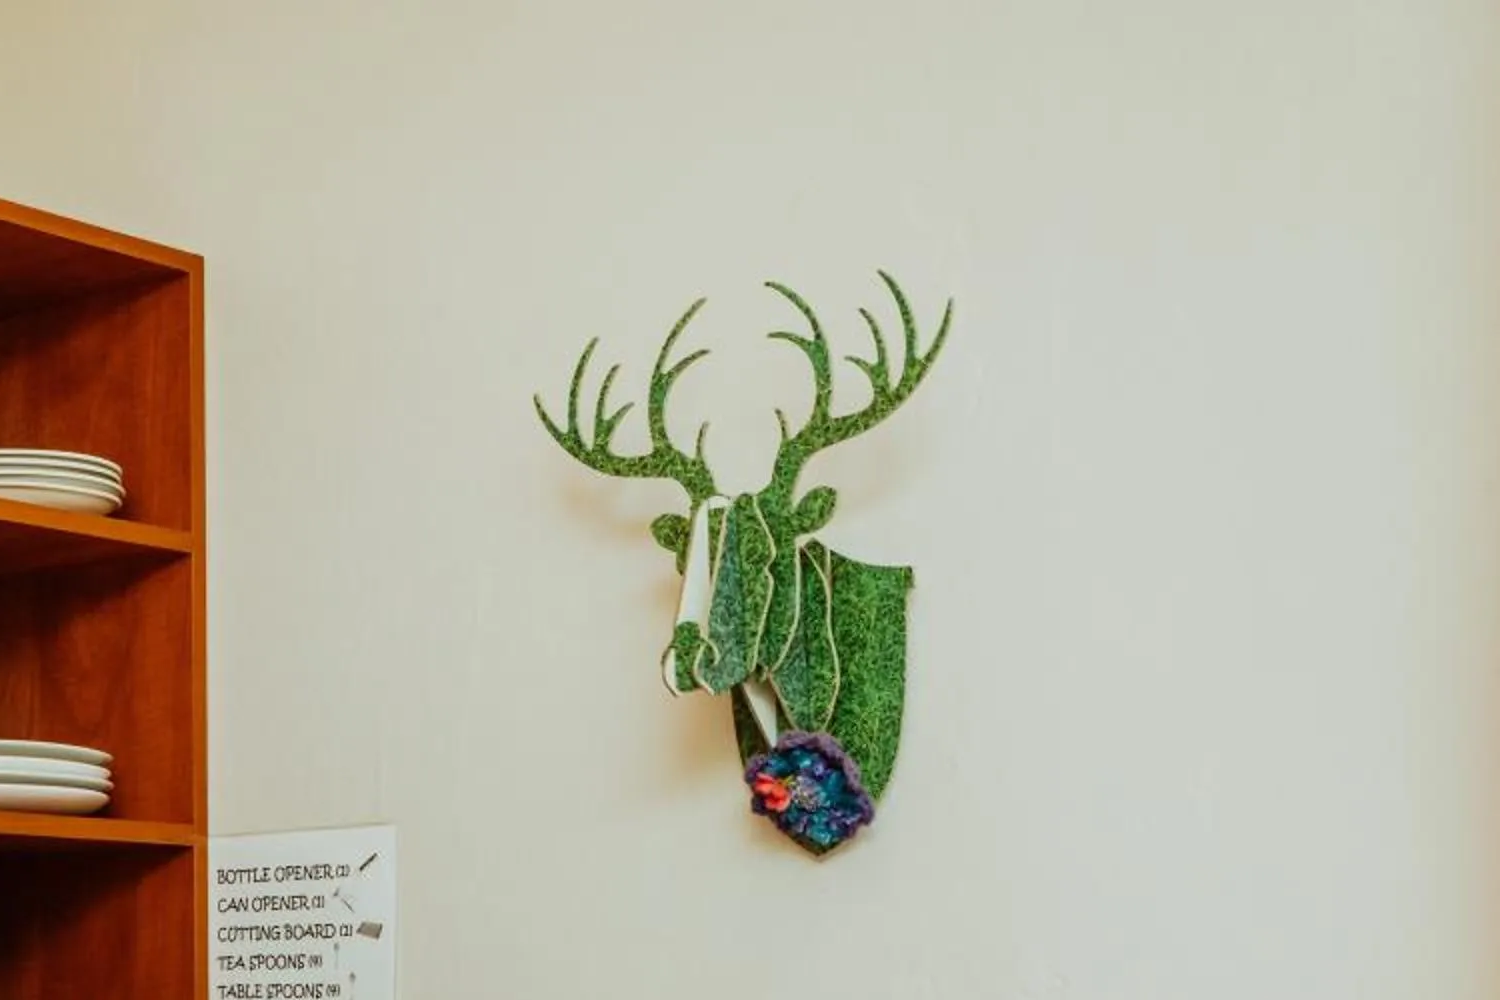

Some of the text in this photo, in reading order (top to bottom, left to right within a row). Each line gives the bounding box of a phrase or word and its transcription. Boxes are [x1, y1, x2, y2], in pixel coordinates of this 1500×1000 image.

[217, 867, 271, 884] BOTTLE
[274, 864, 334, 882] OPENER
[218, 896, 324, 912] CAN OPENER (1)
[218, 925, 280, 942] CUTTING
[285, 924, 336, 940] BOARD
[218, 955, 245, 971] TEA
[250, 954, 304, 971] SPOONS
[217, 985, 262, 1000] TABLE
[266, 984, 323, 999] SPOONS
